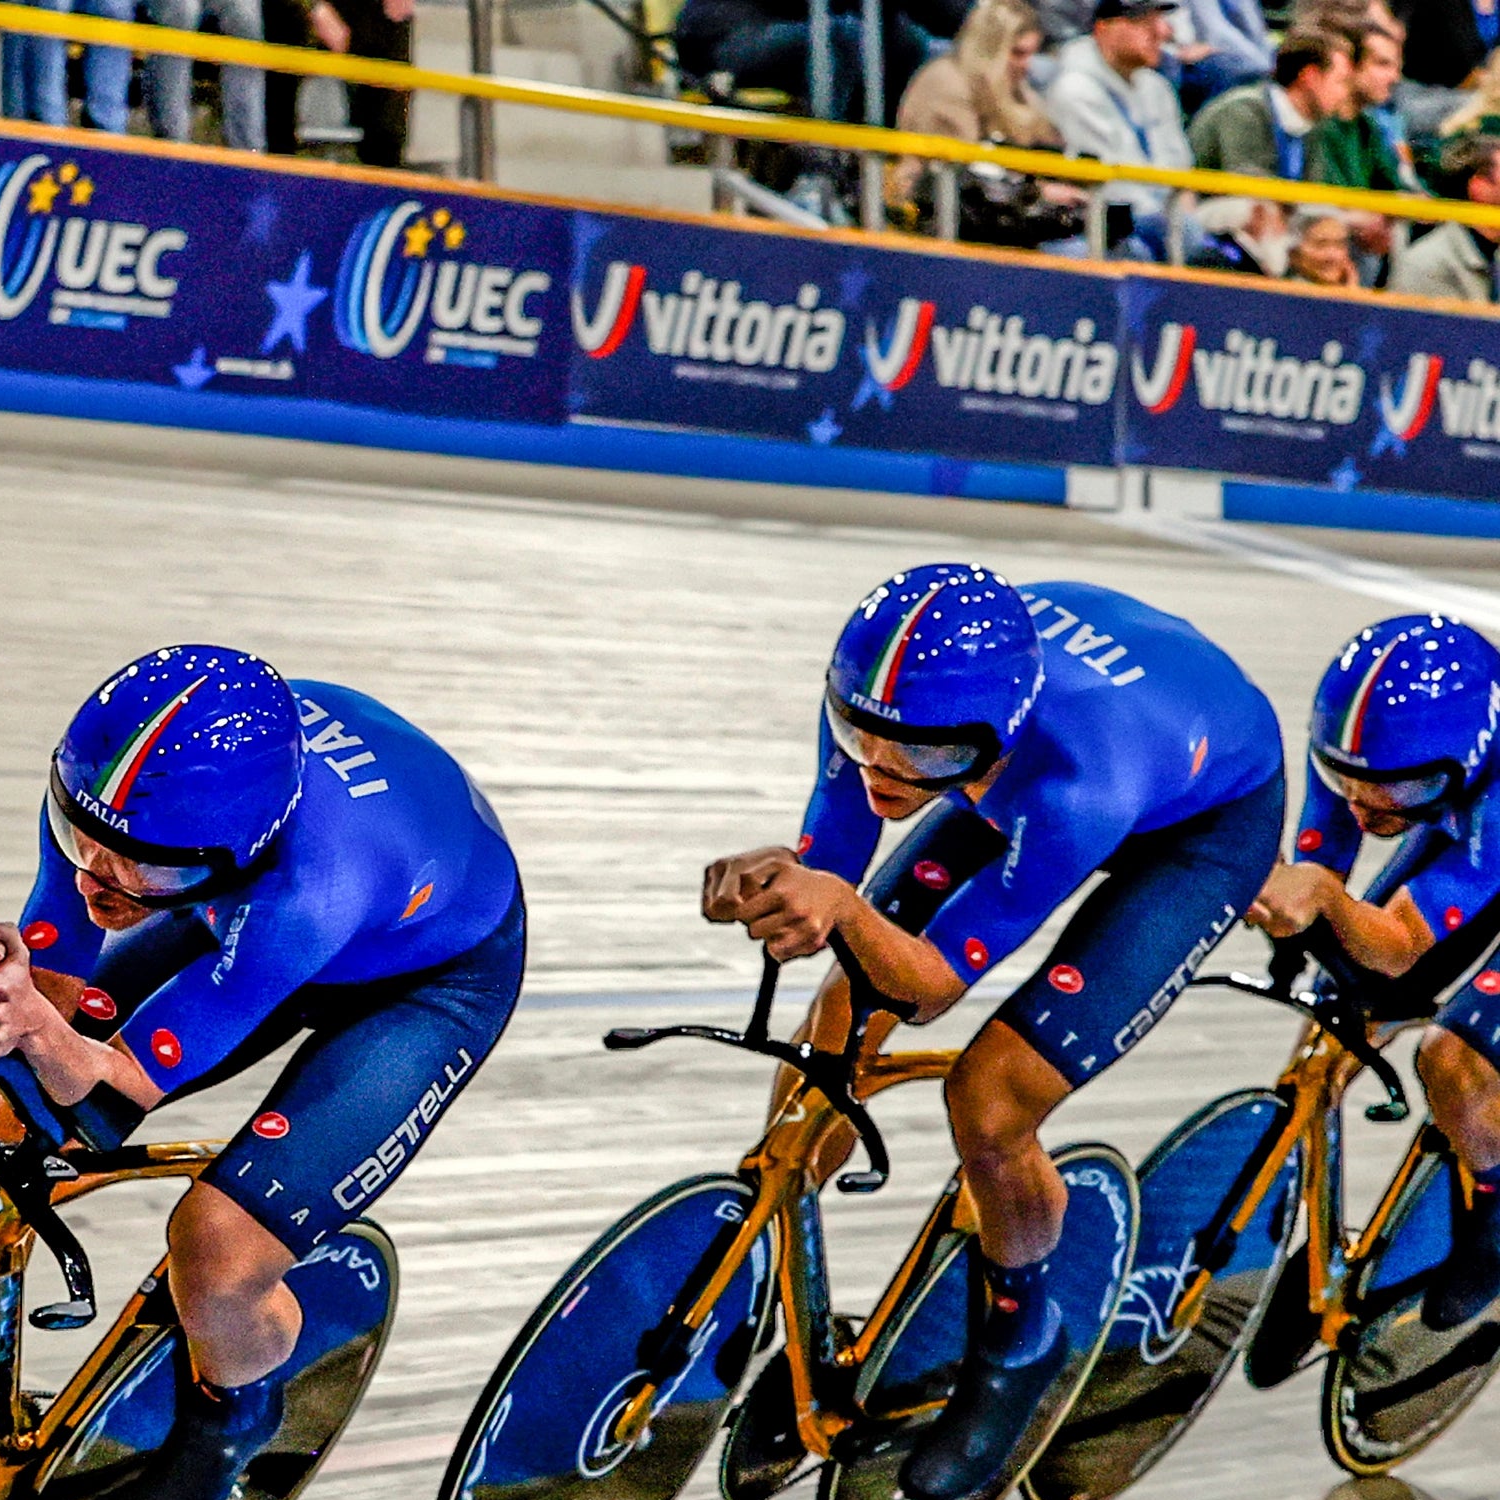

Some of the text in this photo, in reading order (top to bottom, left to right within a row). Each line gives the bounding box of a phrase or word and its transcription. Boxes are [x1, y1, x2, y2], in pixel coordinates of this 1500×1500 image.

[55, 217, 187, 299] UEC
[431, 261, 551, 337] UEC
[643, 270, 846, 374] vittoria
[932, 305, 1119, 405] vittoria
[1194, 329, 1365, 425] vittoria
[75, 789, 129, 834] ITALIA
